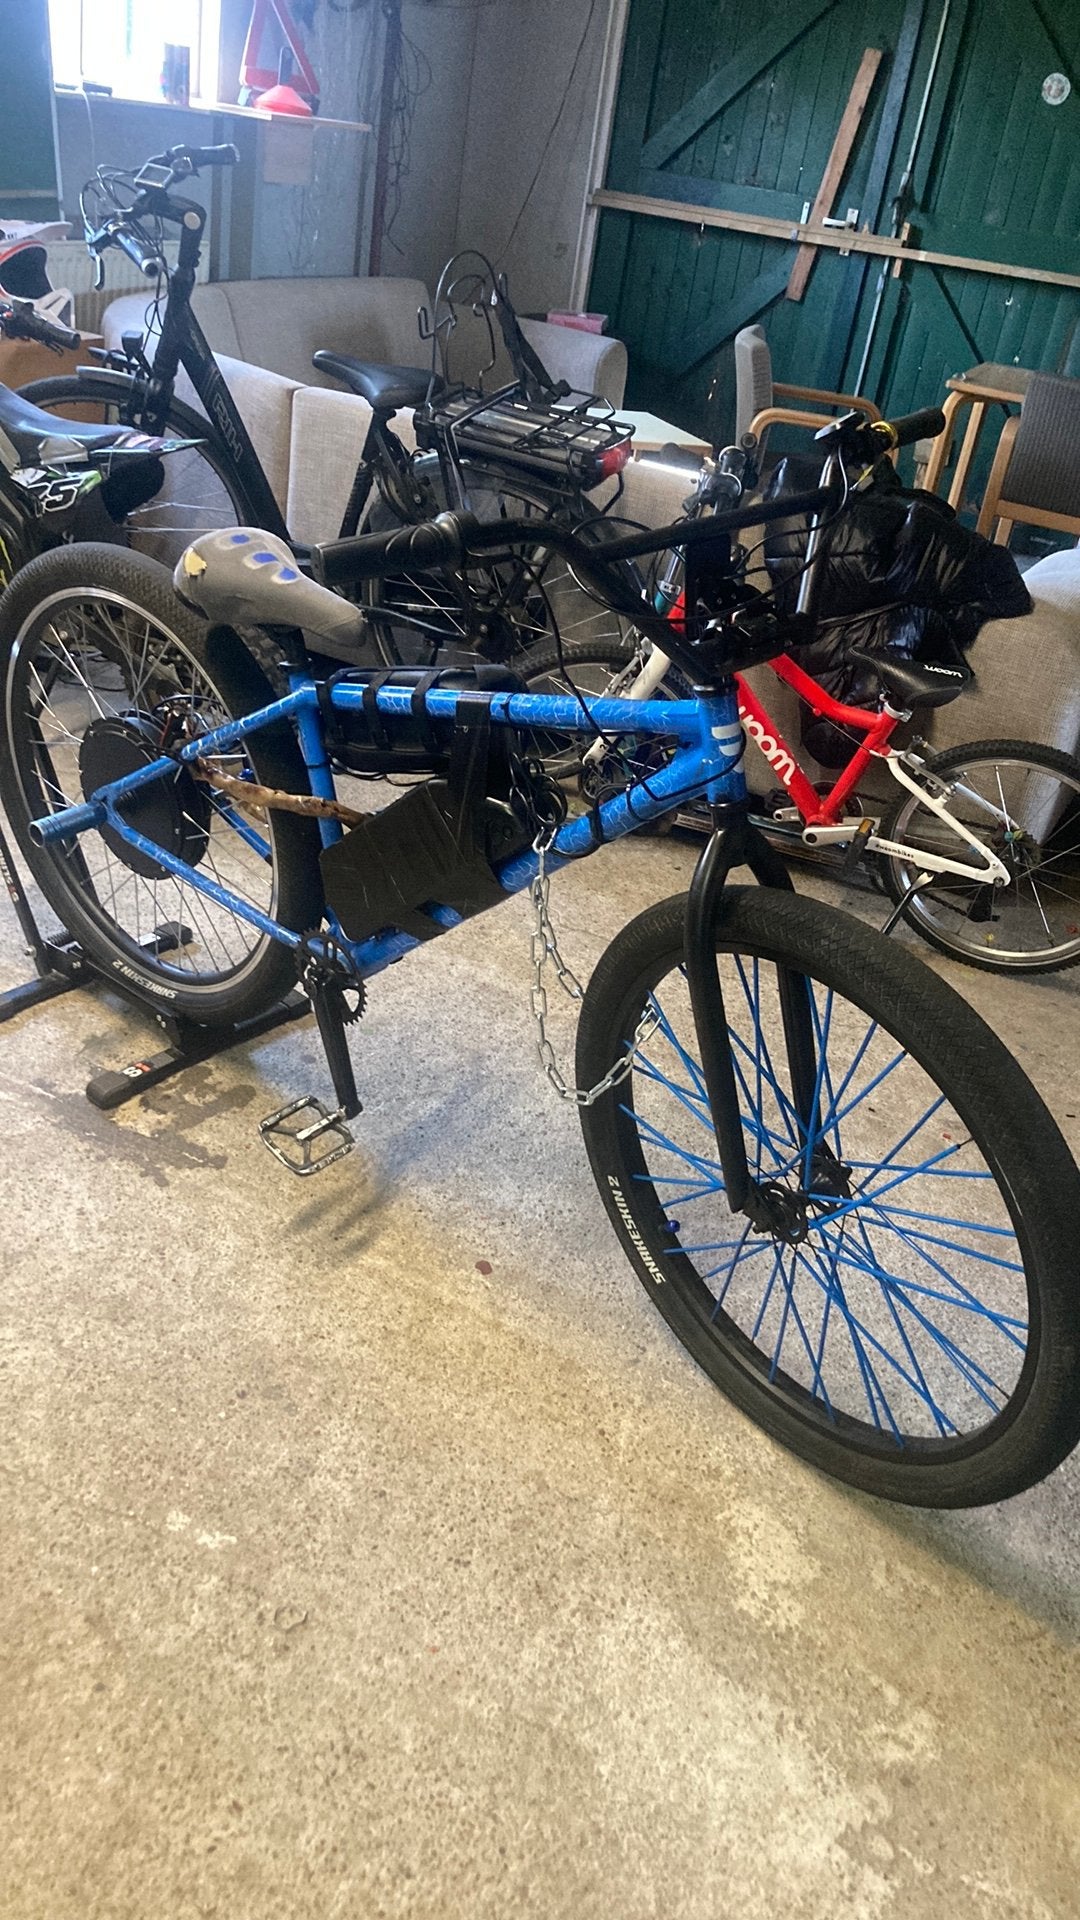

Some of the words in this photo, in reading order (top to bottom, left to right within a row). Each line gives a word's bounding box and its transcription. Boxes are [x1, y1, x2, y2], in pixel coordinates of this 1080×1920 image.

[923, 664, 963, 678] woom
[112, 959, 124, 969] 2
[120, 965, 179, 999] SNAKESKIN
[607, 1175, 620, 1187] 2
[612, 1189, 666, 1285] SNAKESKIN
